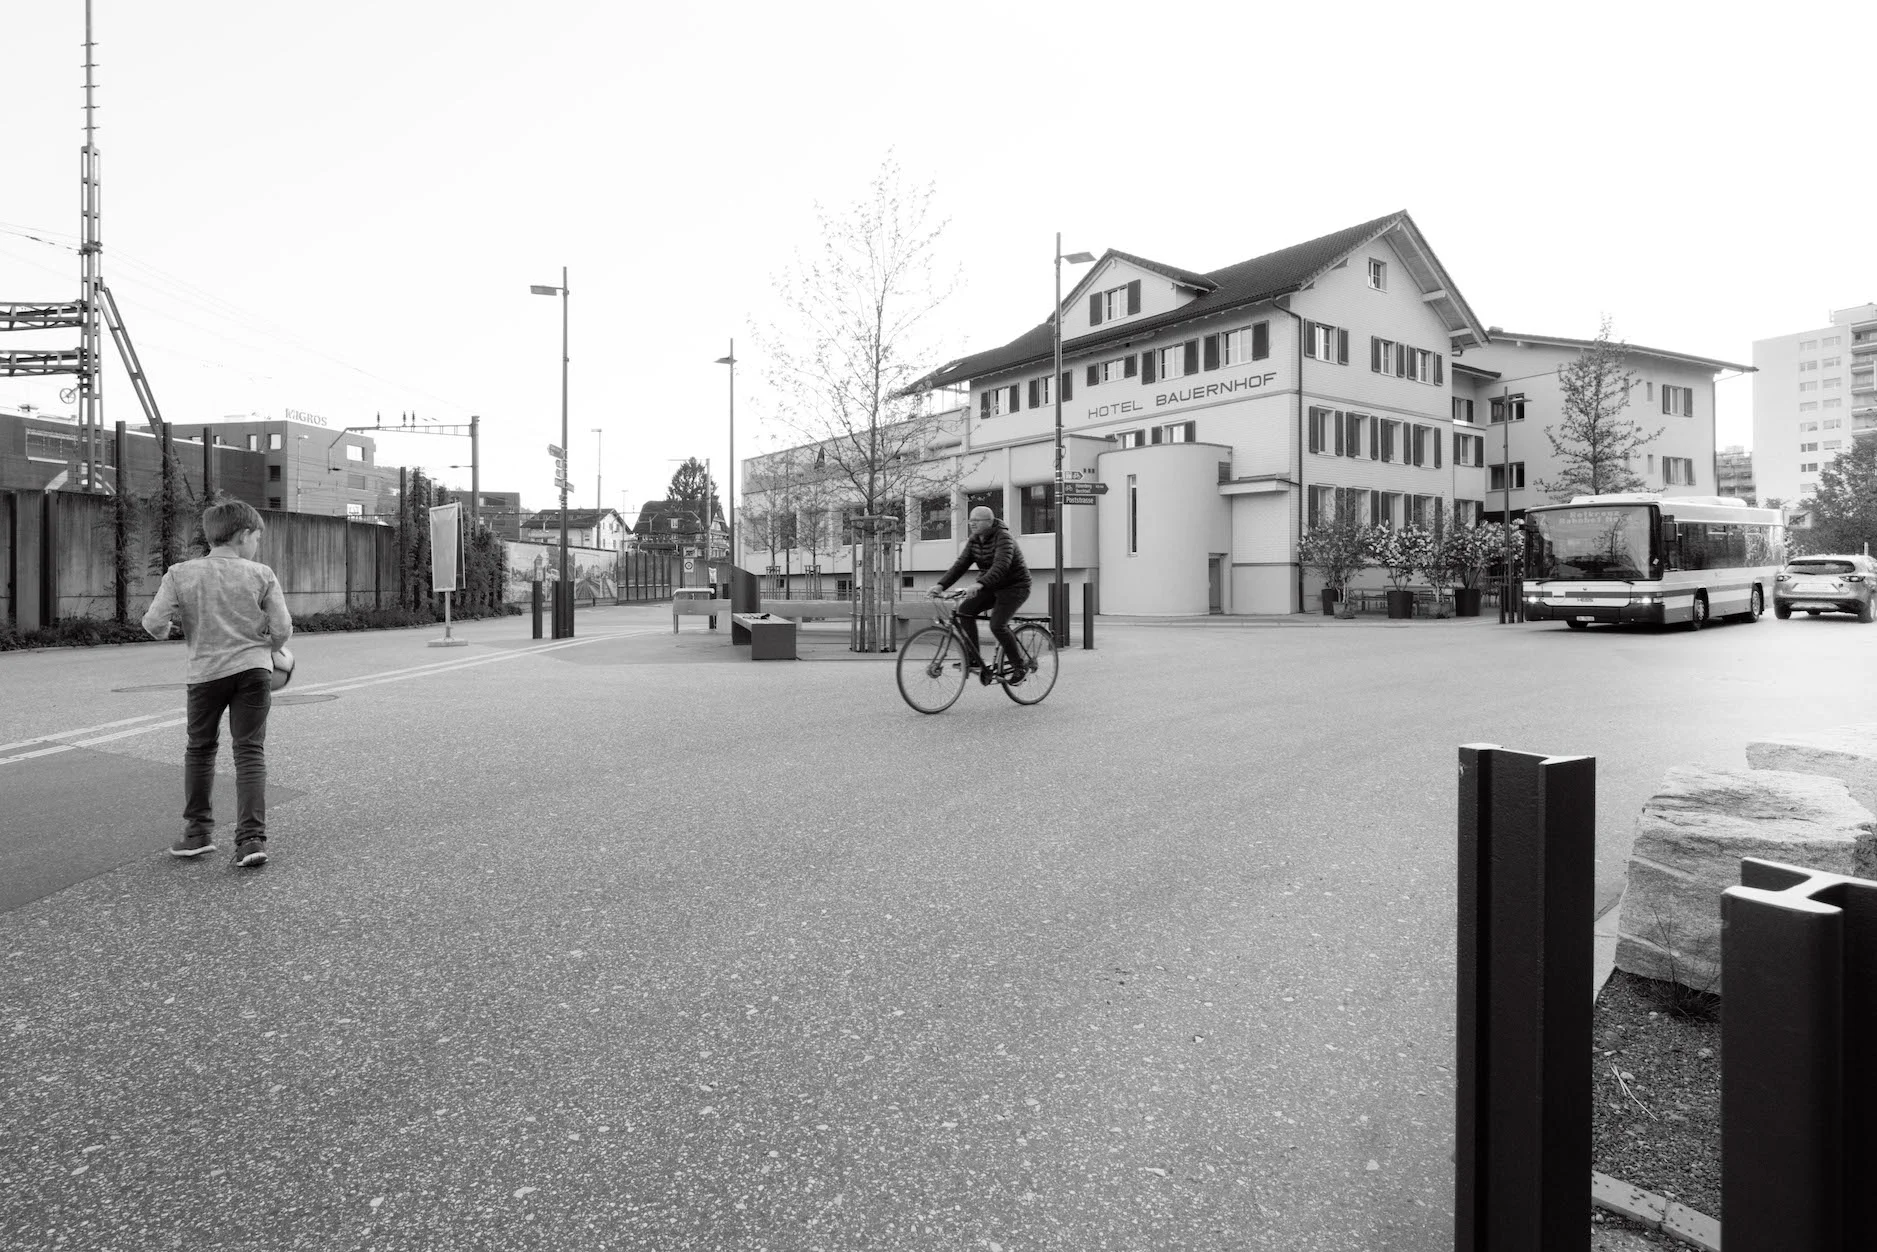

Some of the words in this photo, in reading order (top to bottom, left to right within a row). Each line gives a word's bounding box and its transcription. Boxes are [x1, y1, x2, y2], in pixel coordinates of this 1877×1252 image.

[1088, 400, 1143, 419] HOTEL
[1156, 371, 1277, 407] BAUERNHOF
[285, 407, 328, 426] MIGROS
[1066, 496, 1094, 504] Poststrasse
[1559, 516, 1601, 525] Bahnhof
